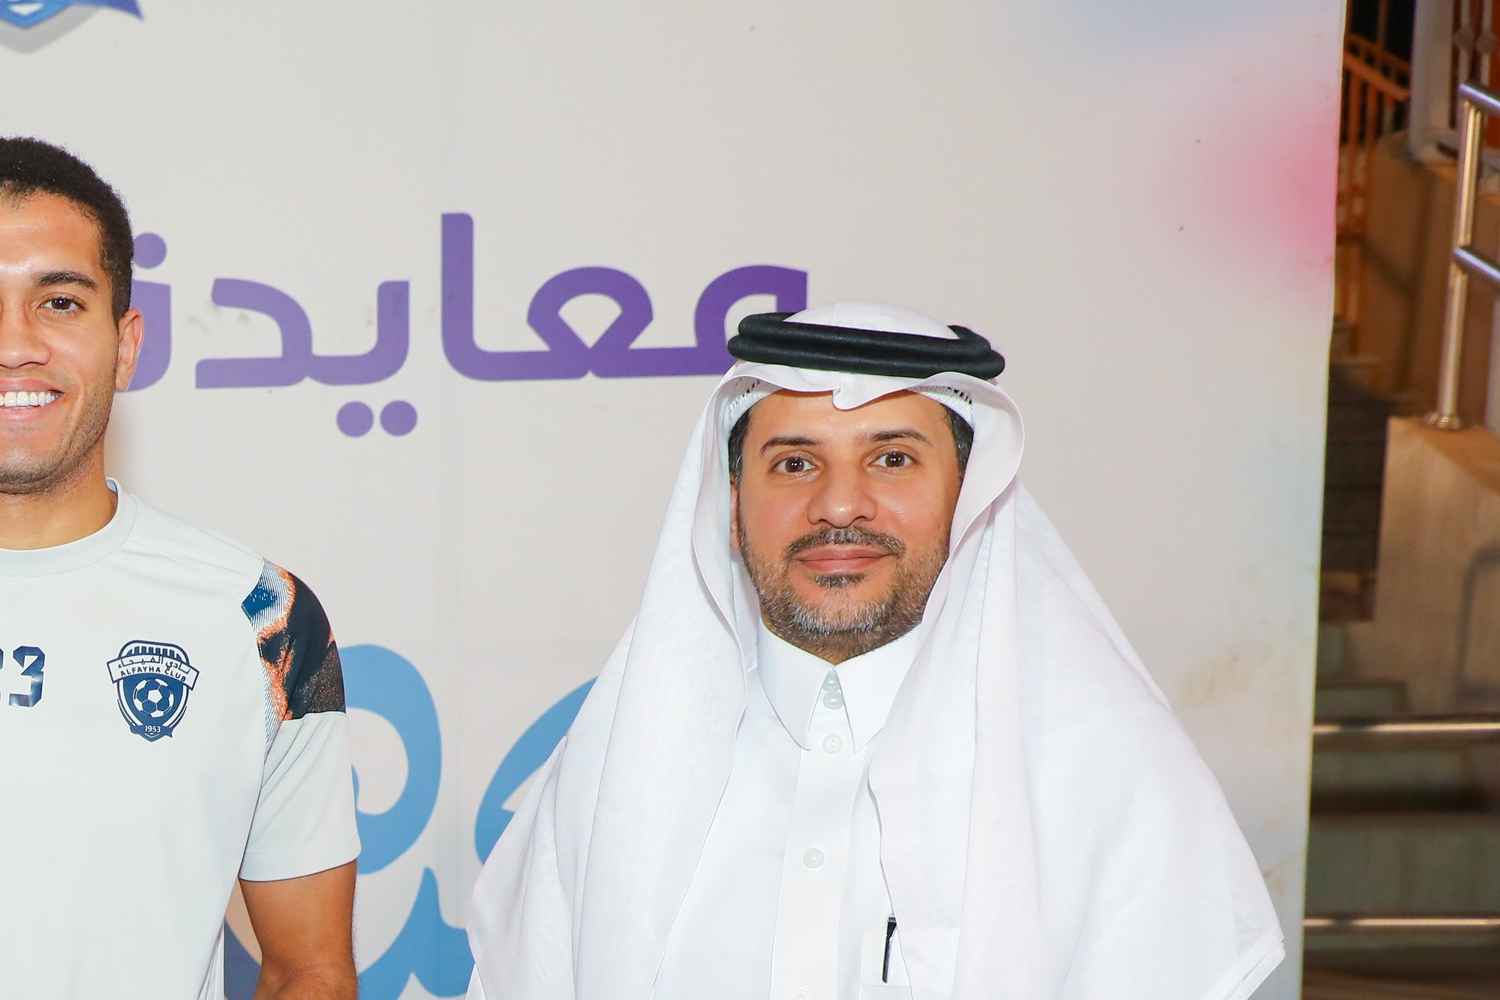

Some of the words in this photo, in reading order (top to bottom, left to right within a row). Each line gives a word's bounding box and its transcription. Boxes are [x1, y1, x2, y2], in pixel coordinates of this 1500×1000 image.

[120, 665, 161, 677] ALFAYHA
[164, 668, 187, 682] CLUB
[145, 725, 161, 733] 1953
